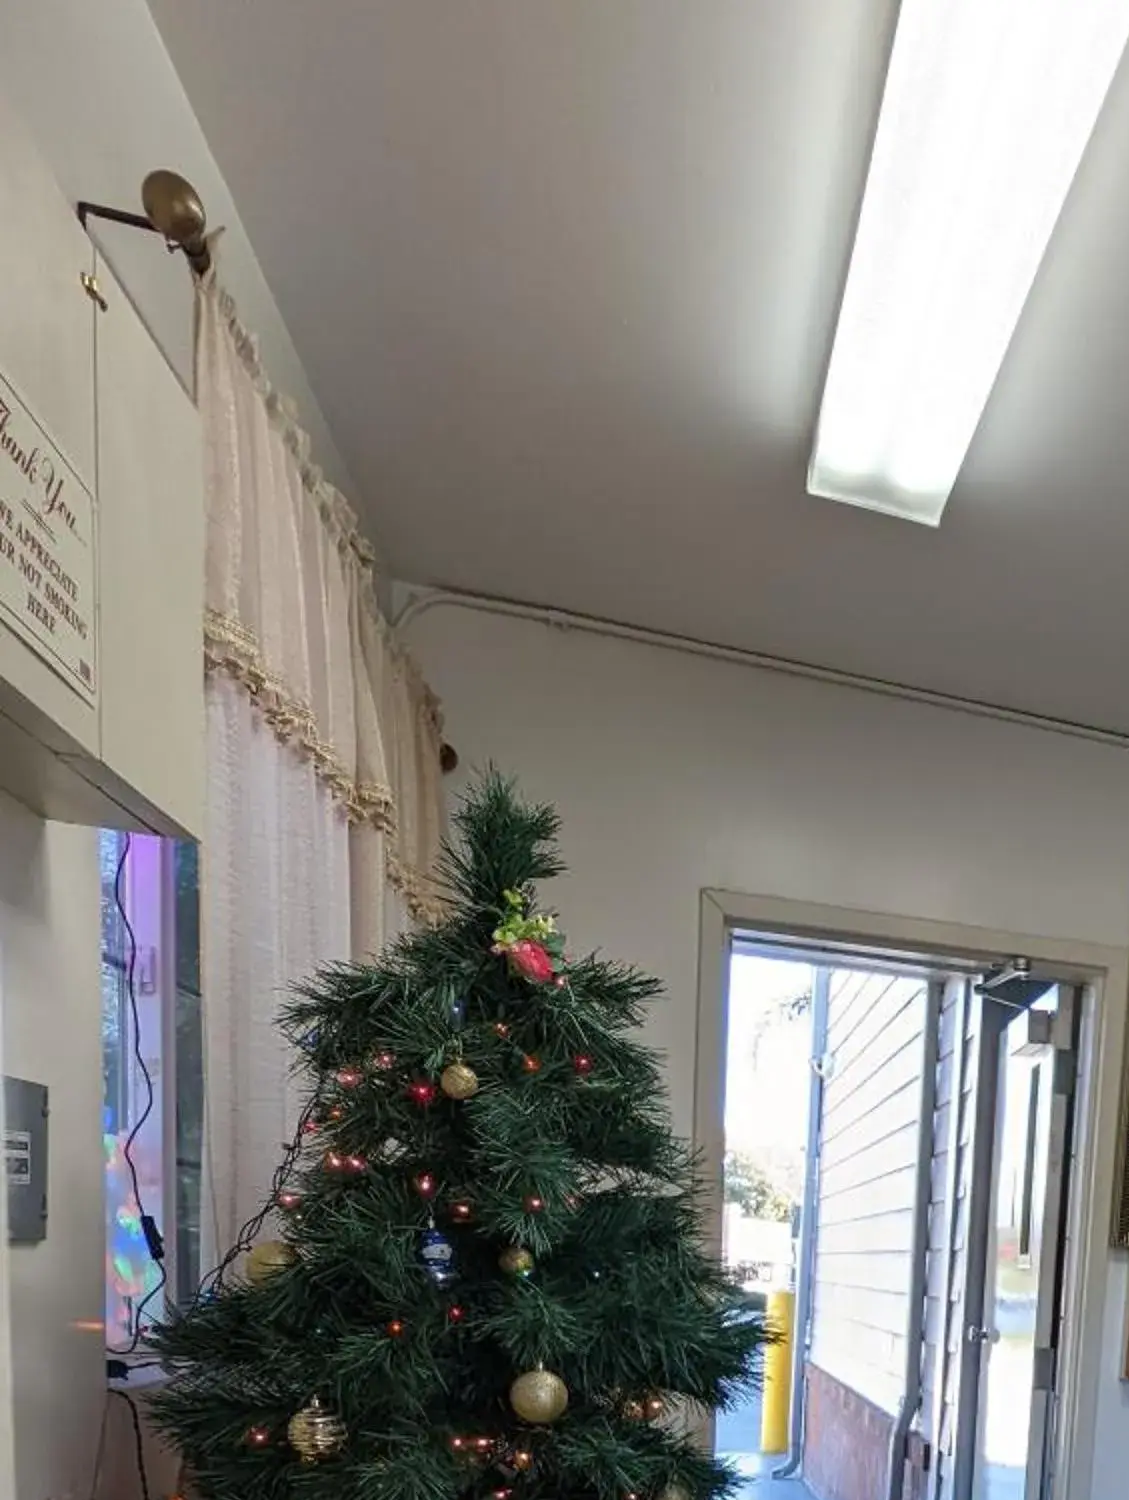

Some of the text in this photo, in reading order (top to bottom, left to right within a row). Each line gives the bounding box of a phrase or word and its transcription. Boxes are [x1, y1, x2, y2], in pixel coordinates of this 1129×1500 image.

[0, 396, 38, 485] hank
[16, 520, 79, 602] APPRECIATE
[19, 553, 42, 589] NOT
[27, 591, 55, 634] HERE
